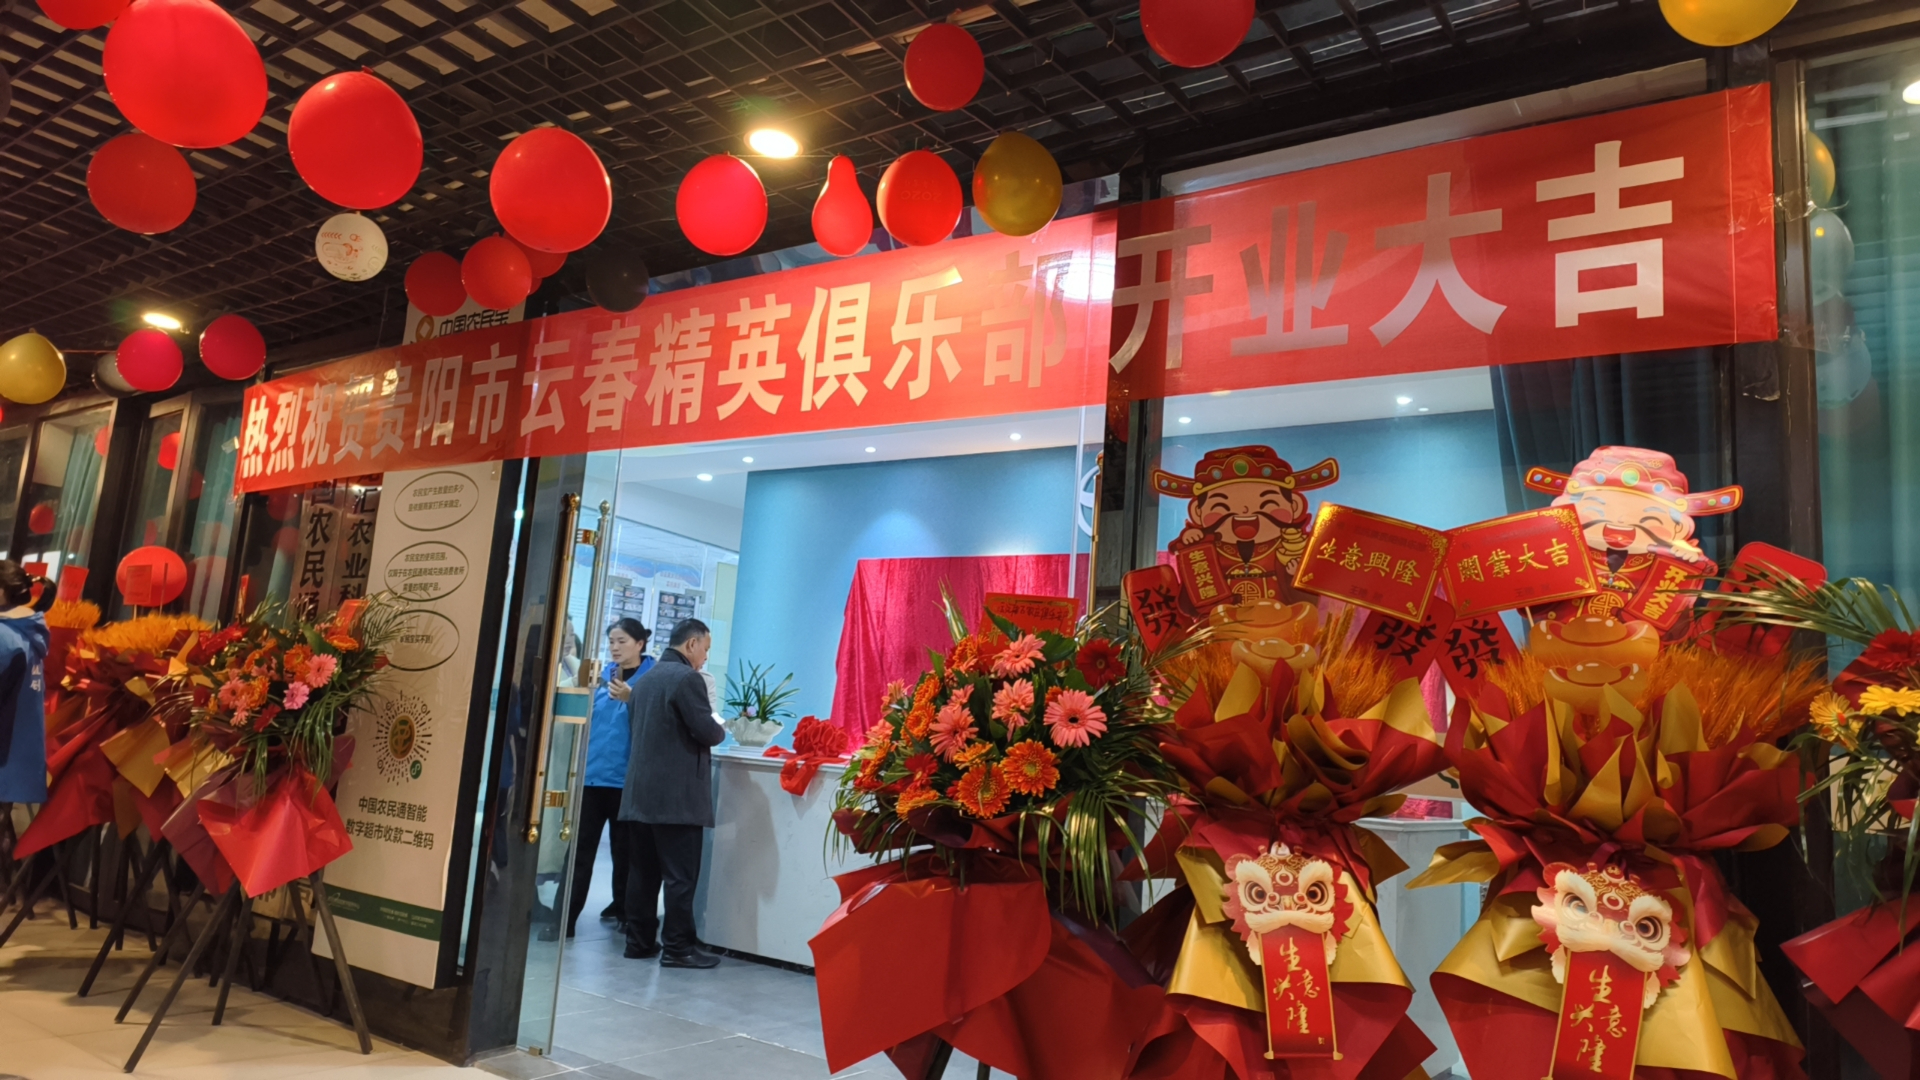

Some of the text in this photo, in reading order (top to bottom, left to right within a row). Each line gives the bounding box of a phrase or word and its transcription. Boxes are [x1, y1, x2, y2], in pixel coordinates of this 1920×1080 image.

[242, 140, 1685, 478] 热烈祝贺贵阳市云春精英俱乐部开业大吉
[1133, 583, 1182, 637] 發
[1643, 565, 1688, 620] 开业大吉
[1374, 614, 1437, 666] 發
[1444, 618, 1505, 680] 發
[345, 818, 434, 850] 数字超市收款二维码
[358, 796, 428, 823] 中国农民通智能
